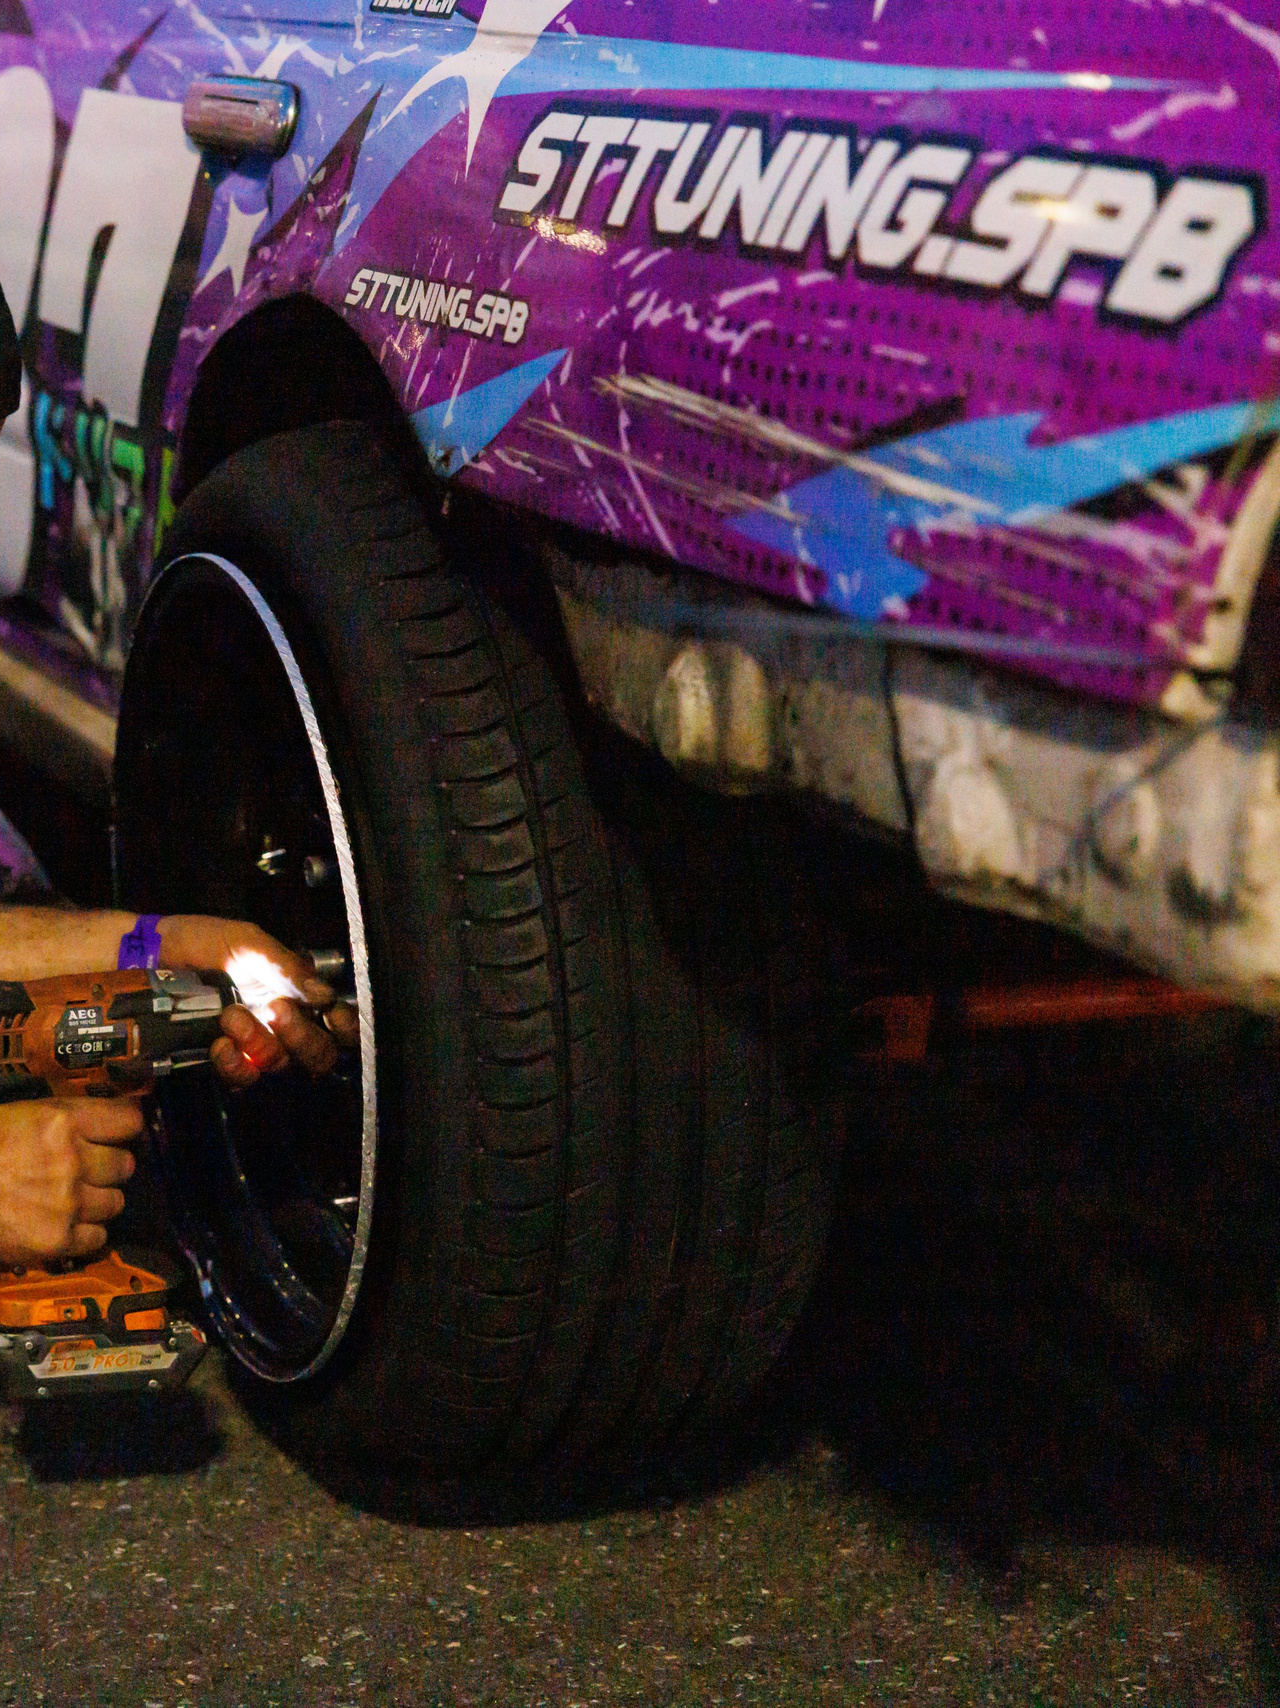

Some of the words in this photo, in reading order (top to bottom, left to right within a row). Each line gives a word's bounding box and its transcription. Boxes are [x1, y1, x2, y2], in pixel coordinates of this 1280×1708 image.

[498, 111, 1256, 323] STTUNING.SPB
[344, 268, 529, 344] STTUNING.SPB
[68, 1008, 97, 1020] AEG
